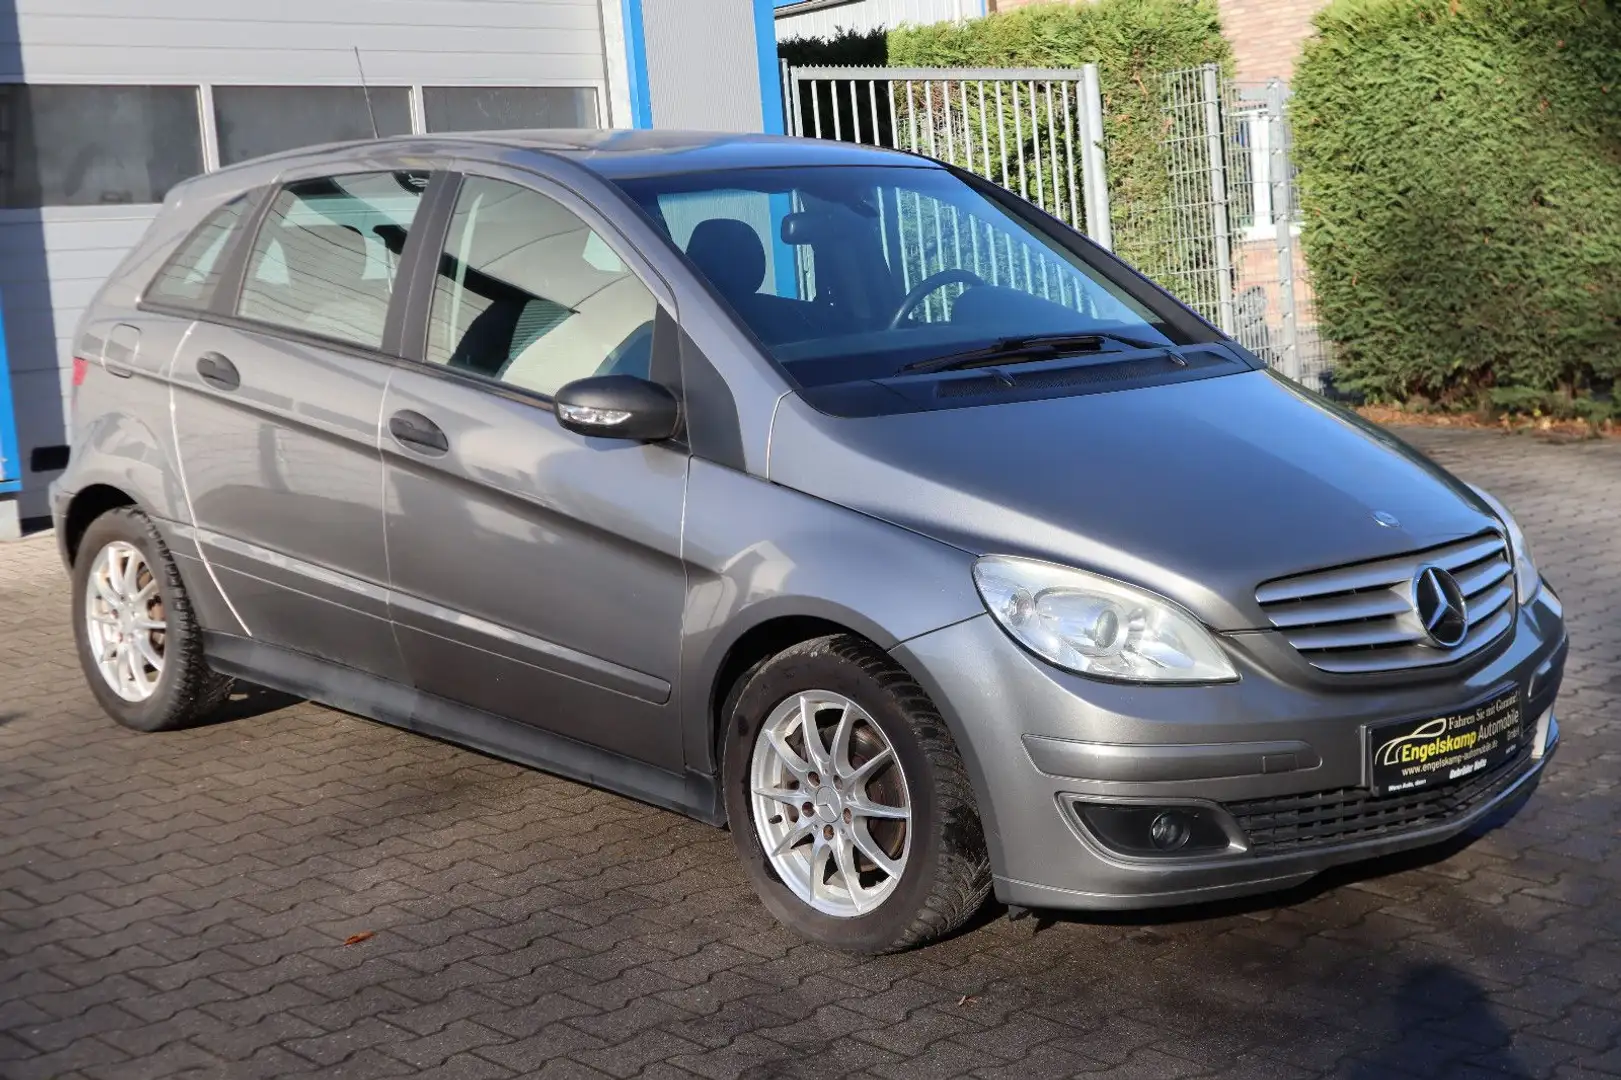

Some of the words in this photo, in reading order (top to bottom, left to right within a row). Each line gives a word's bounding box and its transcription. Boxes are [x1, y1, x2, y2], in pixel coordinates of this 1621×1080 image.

[1401, 731, 1477, 764] Engelskamp
[1477, 707, 1519, 741] Automobile
[1448, 715, 1475, 730] Fahren
[1476, 708, 1485, 721] Sie
[1486, 704, 1495, 717] mit
